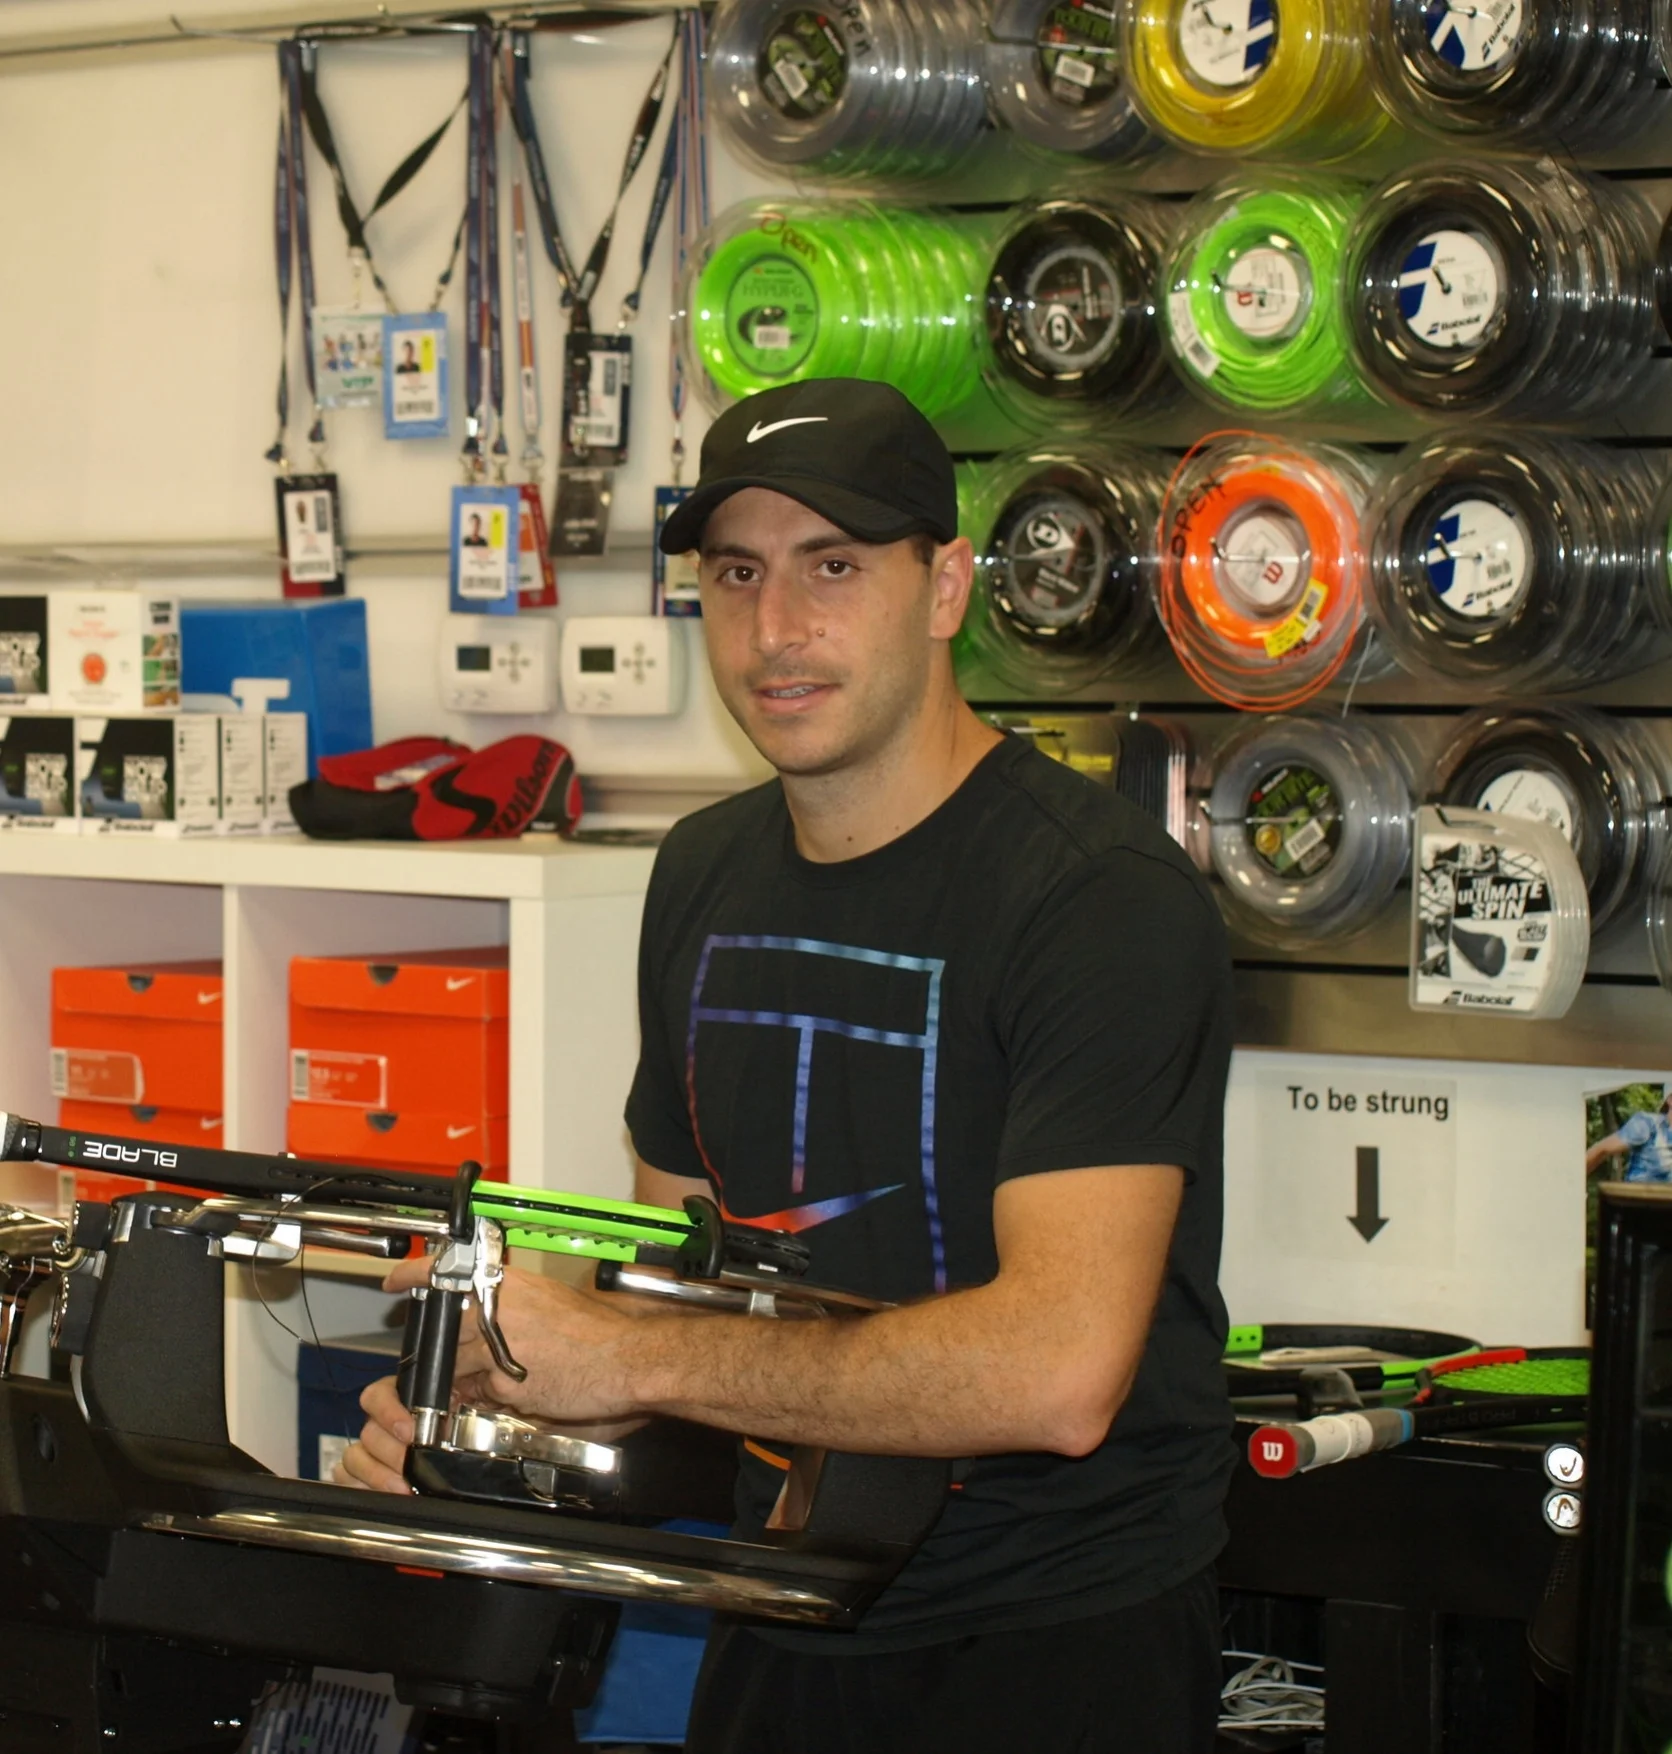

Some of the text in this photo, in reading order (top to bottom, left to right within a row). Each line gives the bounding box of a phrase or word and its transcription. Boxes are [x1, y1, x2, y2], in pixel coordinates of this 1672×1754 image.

[1458, 881, 1546, 905] ULTIMATE
[1471, 899, 1526, 920] SPIN
[1463, 992, 1515, 1006] Babolat
[1287, 1086, 1449, 1121] To be strung
[82, 1140, 178, 1168] BLADE
